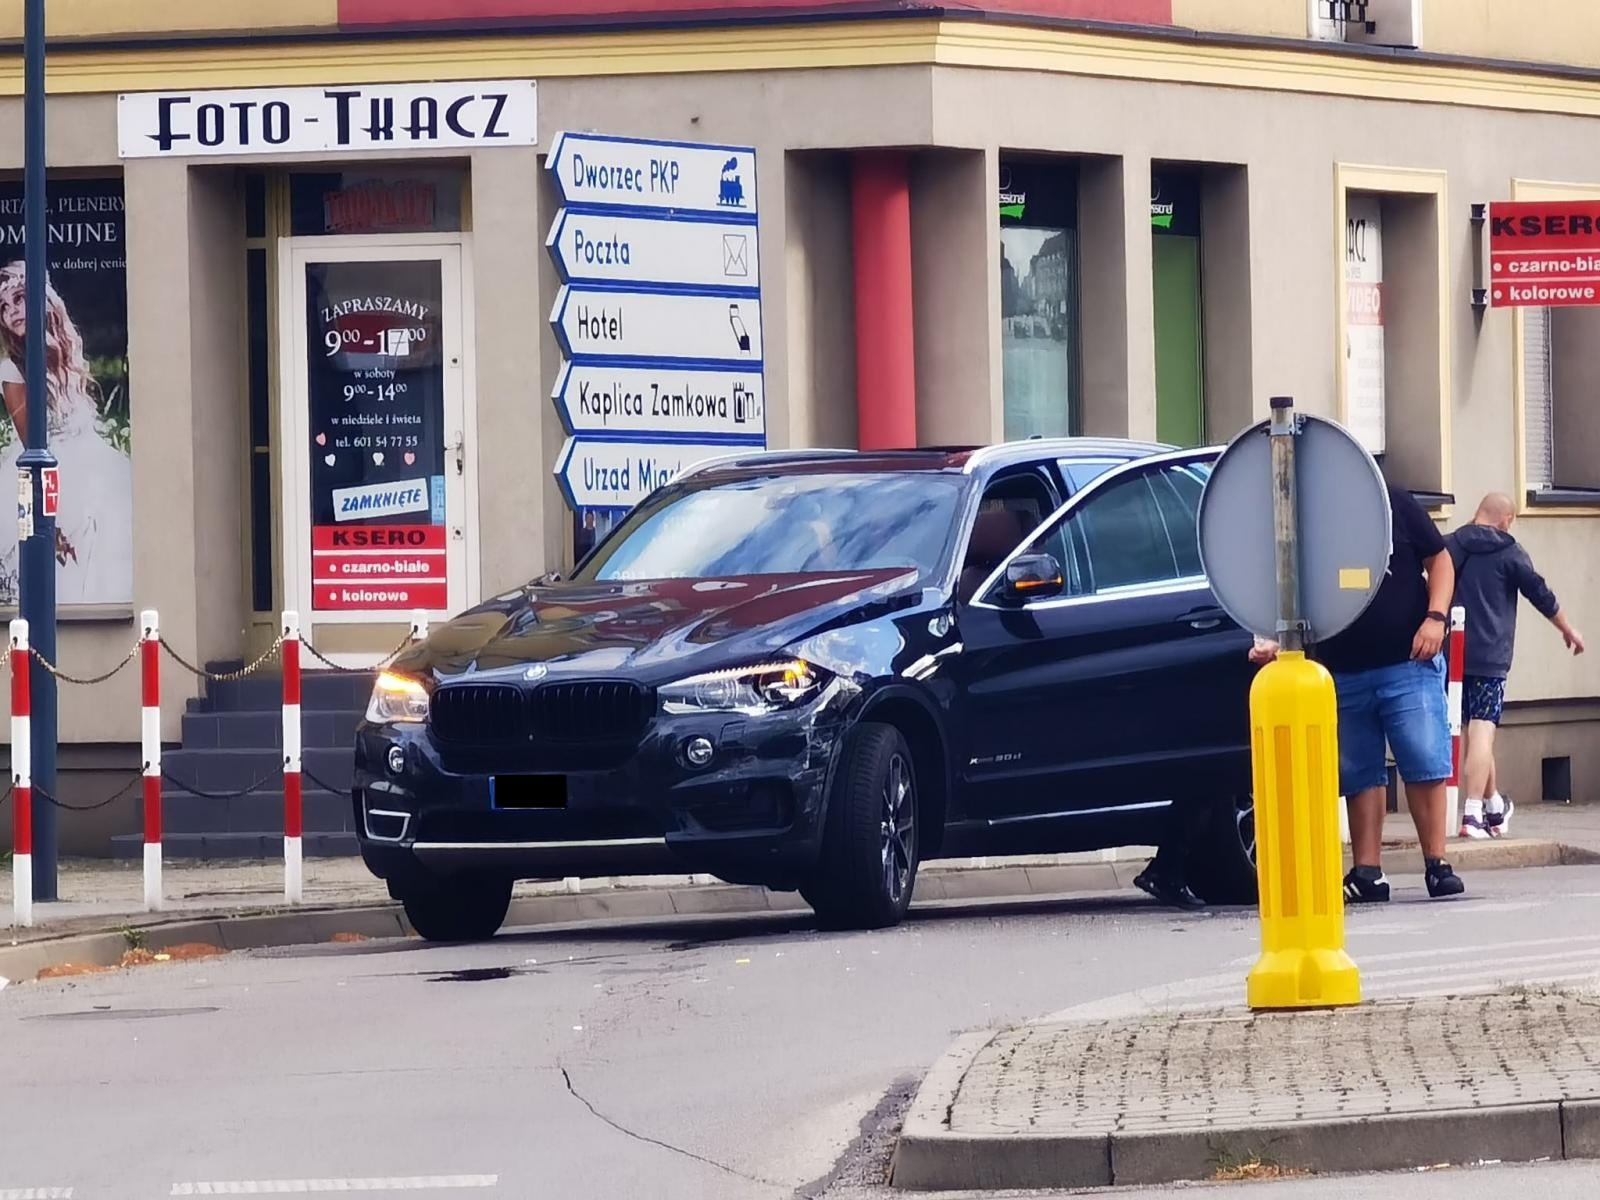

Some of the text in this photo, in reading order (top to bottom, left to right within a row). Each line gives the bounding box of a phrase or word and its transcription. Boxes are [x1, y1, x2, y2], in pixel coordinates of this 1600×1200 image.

[573, 154, 679, 194] Dworzec PKP
[575, 230, 630, 265] Poczta
[51, 261, 61, 270] w
[63, 257, 98, 272] dobrej
[1509, 284, 1595, 300] kolorowe
[321, 296, 429, 322] ZAPRASZAMY
[577, 306, 623, 341] Hotel
[354, 367, 396, 379] w soboty
[579, 381, 727, 426] Kaplica Zamkowa
[331, 417, 339, 425] w
[342, 413, 384, 425] niedziele
[335, 435, 418, 448] tel. 601 54 77 55
[341, 488, 421, 512] ZAMKNIĘTE
[332, 530, 426, 546] KSERO
